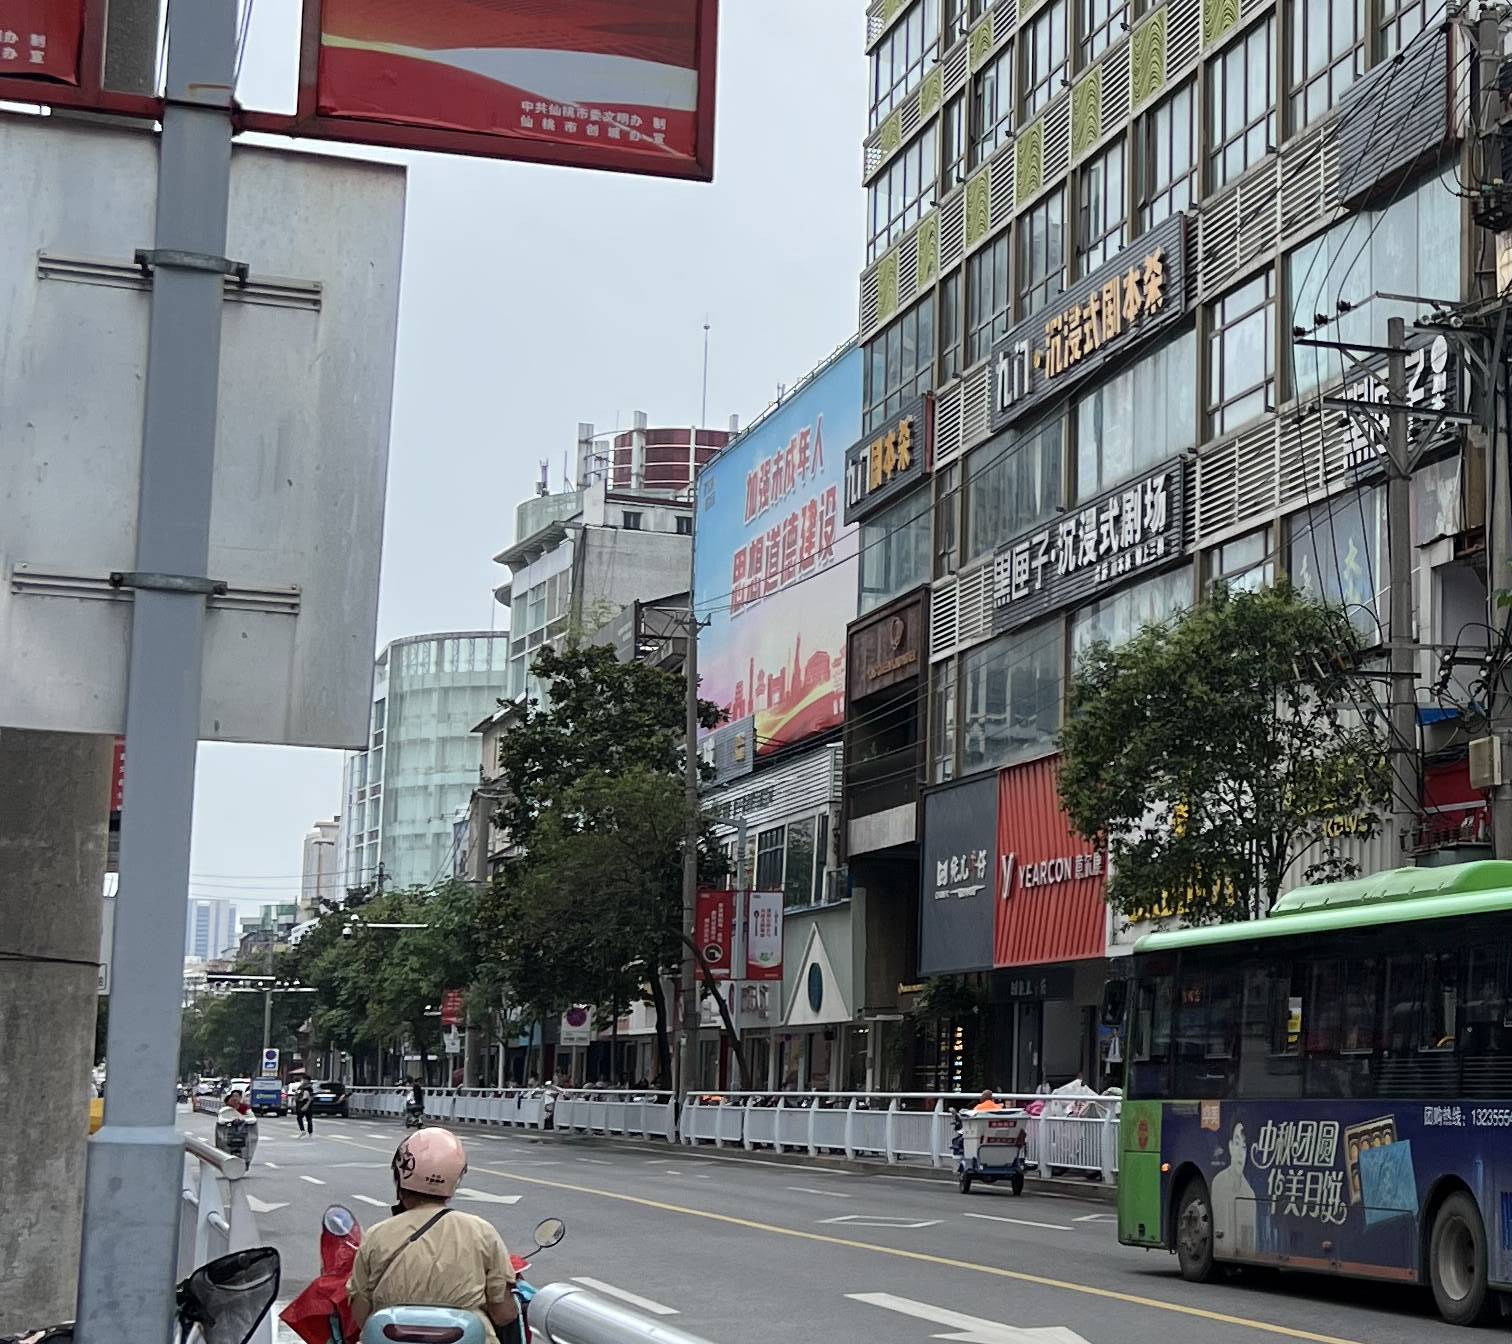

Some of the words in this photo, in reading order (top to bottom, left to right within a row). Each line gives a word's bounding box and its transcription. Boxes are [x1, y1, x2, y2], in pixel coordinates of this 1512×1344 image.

[744, 412, 825, 526] 加强未成年人
[730, 485, 838, 620] 思想道德建设
[993, 473, 1167, 609] 黑匣子·沉浸式剧场
[1018, 858, 1073, 889] YEARCON
[1251, 1120, 1340, 1169] 中秋团圆
[1267, 1168, 1348, 1226] 华美月饼
